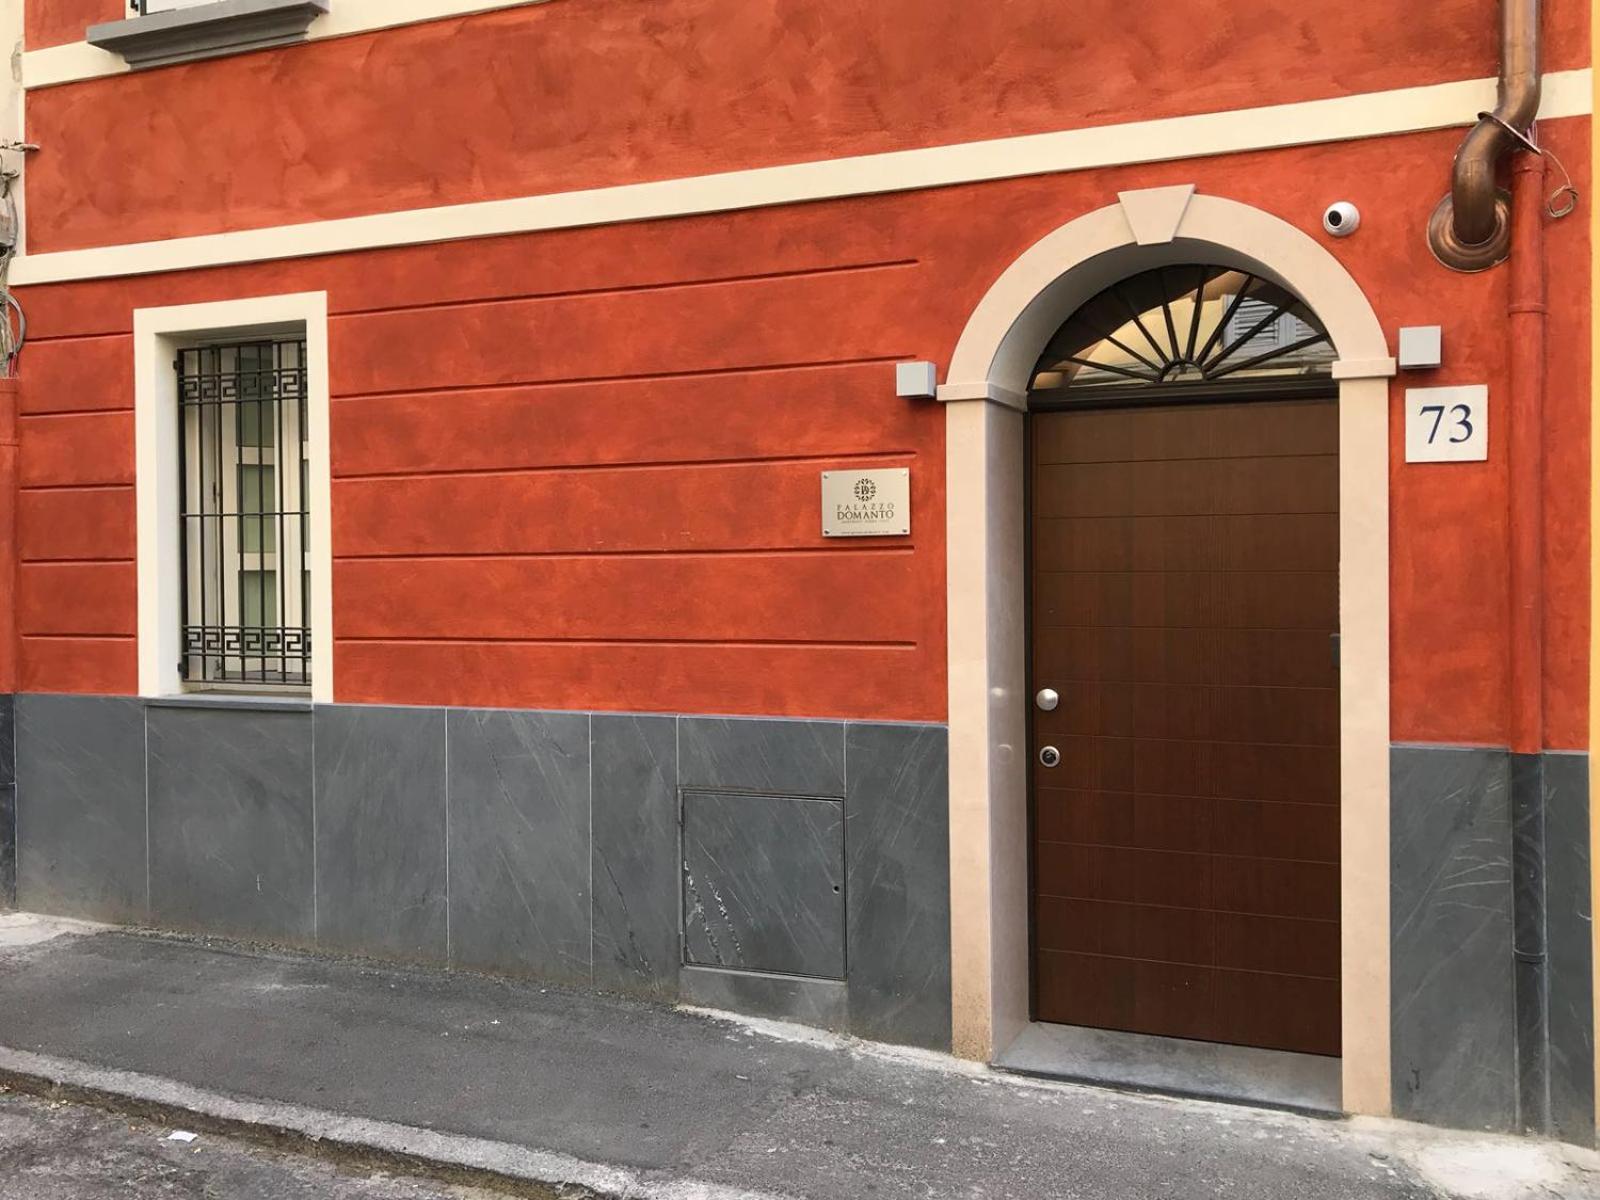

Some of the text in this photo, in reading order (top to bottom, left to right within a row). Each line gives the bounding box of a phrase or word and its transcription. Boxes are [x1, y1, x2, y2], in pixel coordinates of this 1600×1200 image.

[1419, 404, 1473, 444] 73
[837, 502, 895, 511] PALAZZO
[837, 510, 894, 520] DOMANTO
